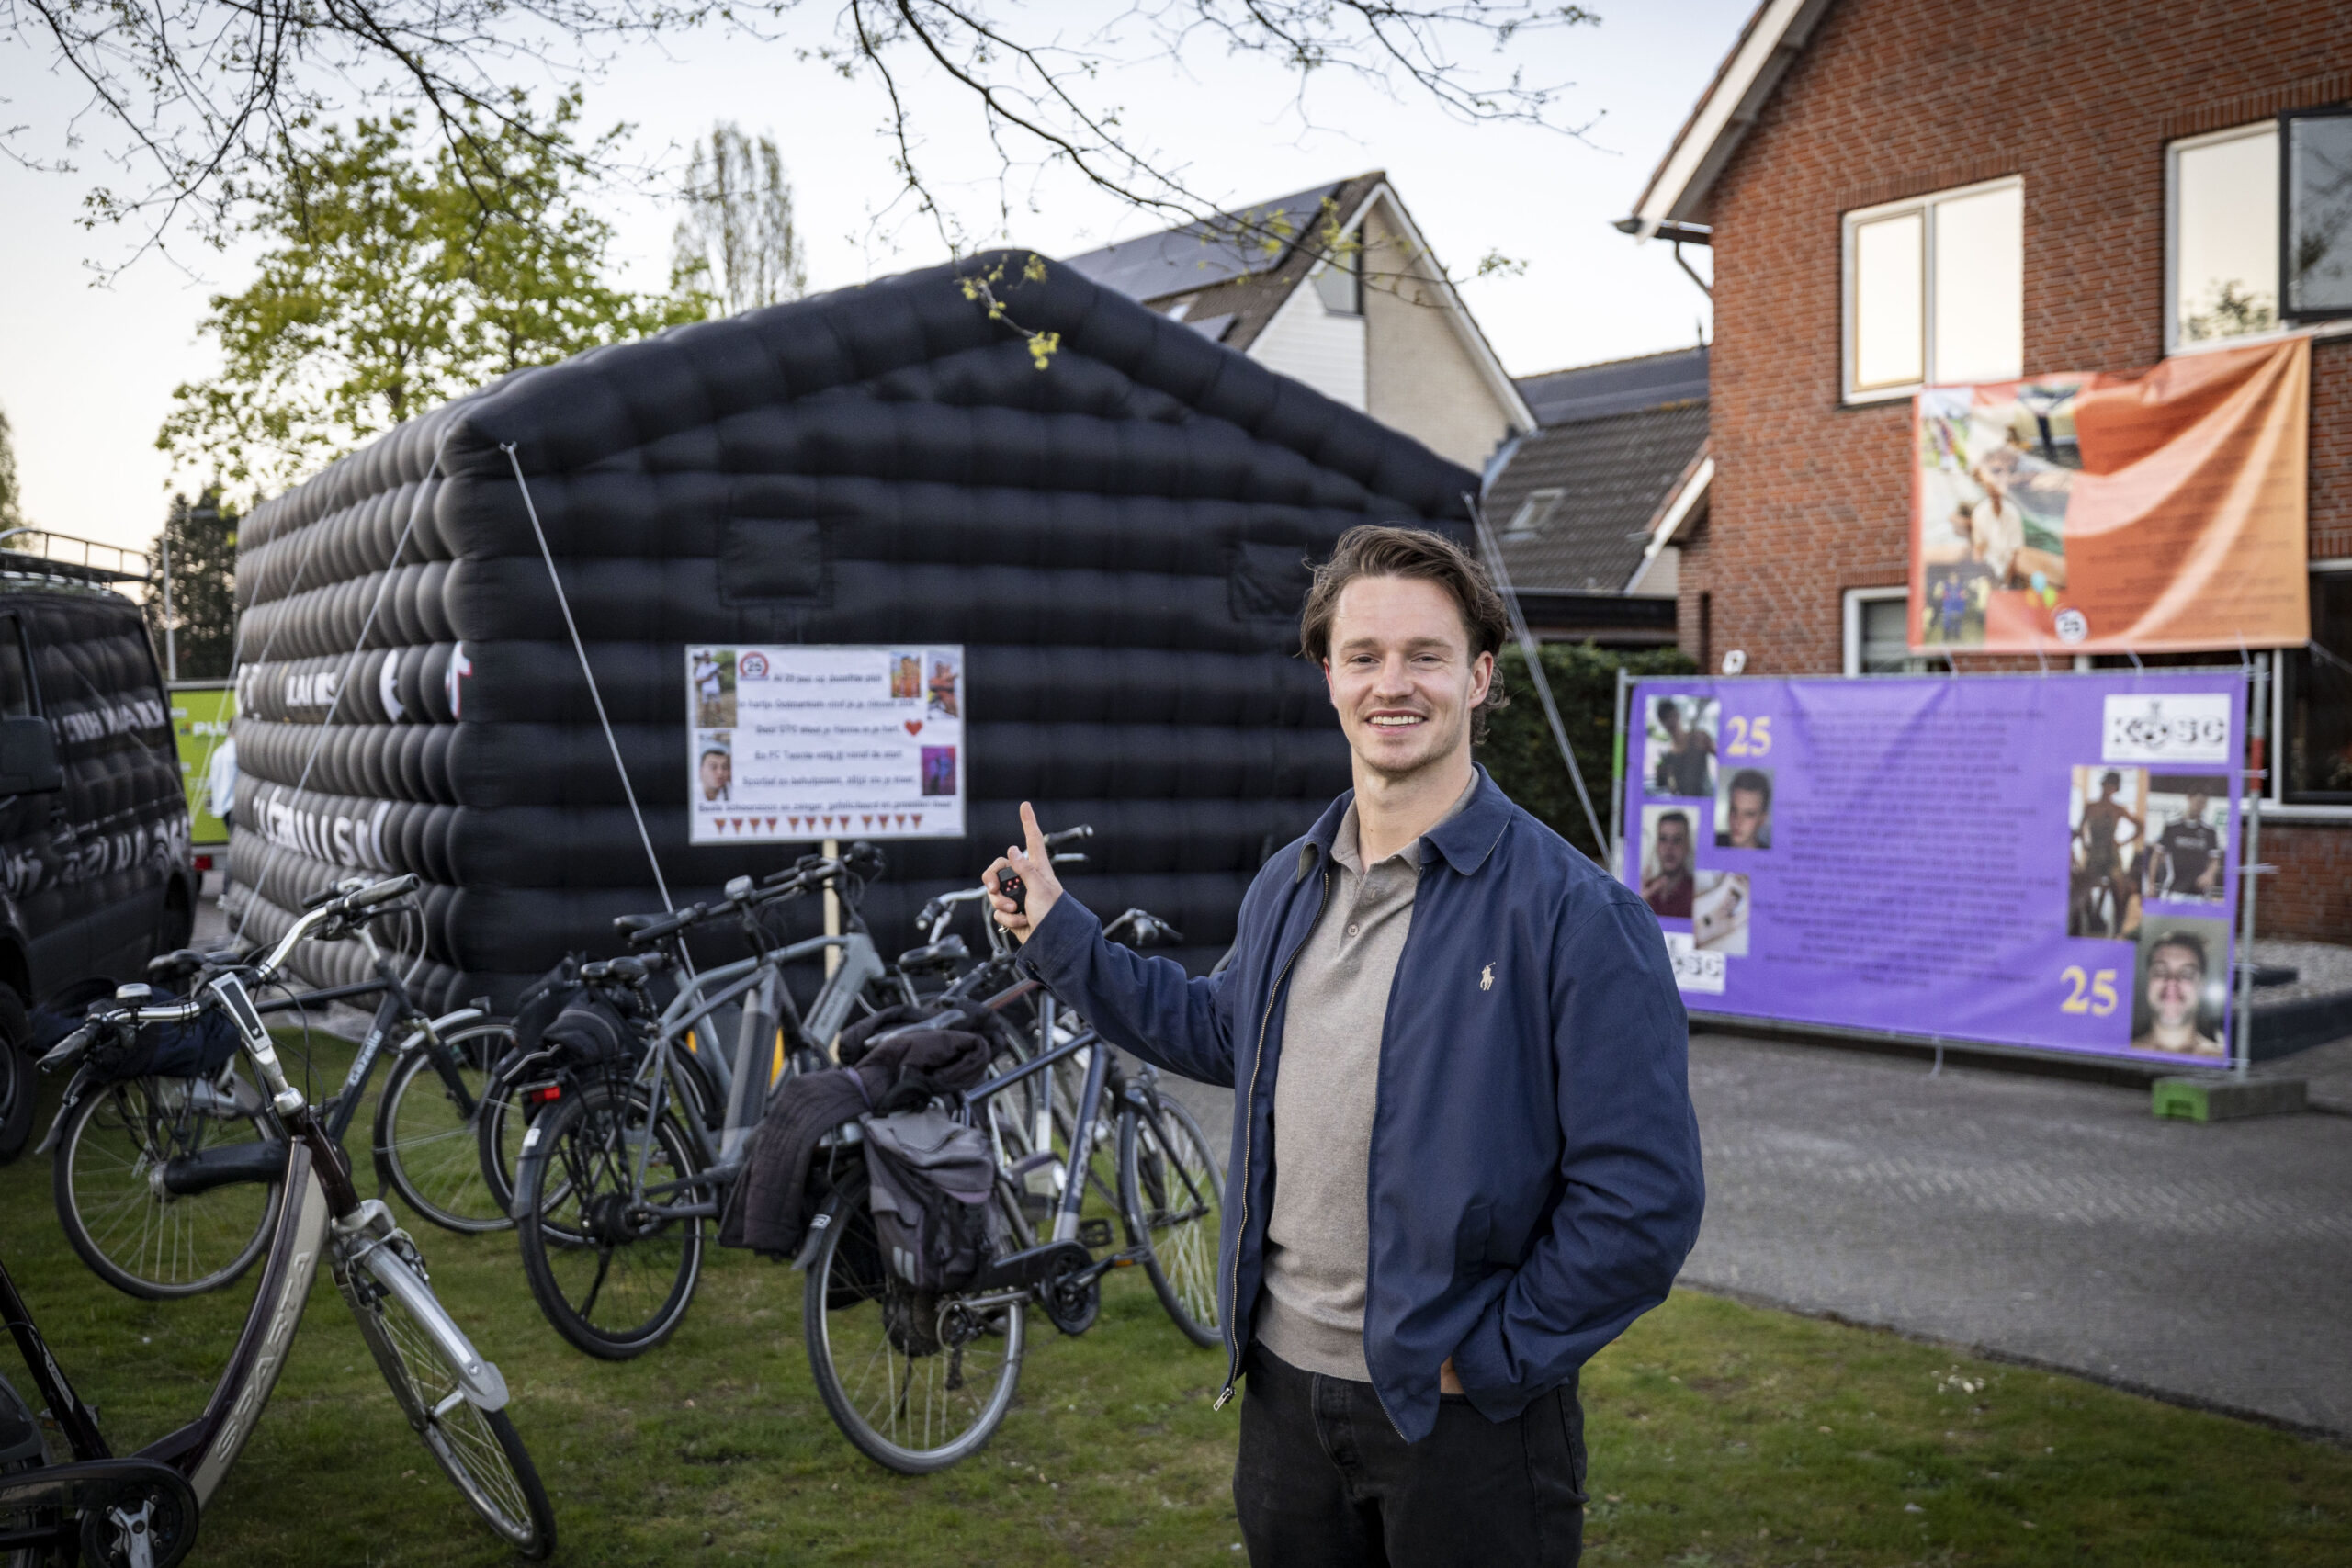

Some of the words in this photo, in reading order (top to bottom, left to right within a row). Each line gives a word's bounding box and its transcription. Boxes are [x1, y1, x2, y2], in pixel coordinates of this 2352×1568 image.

[192, 720, 229, 736] PLU
[1725, 716, 1771, 756] 25
[2060, 965, 2119, 1017] 25
[348, 1029, 383, 1087] Gazelle
[216, 1251, 311, 1463] SPARTA
